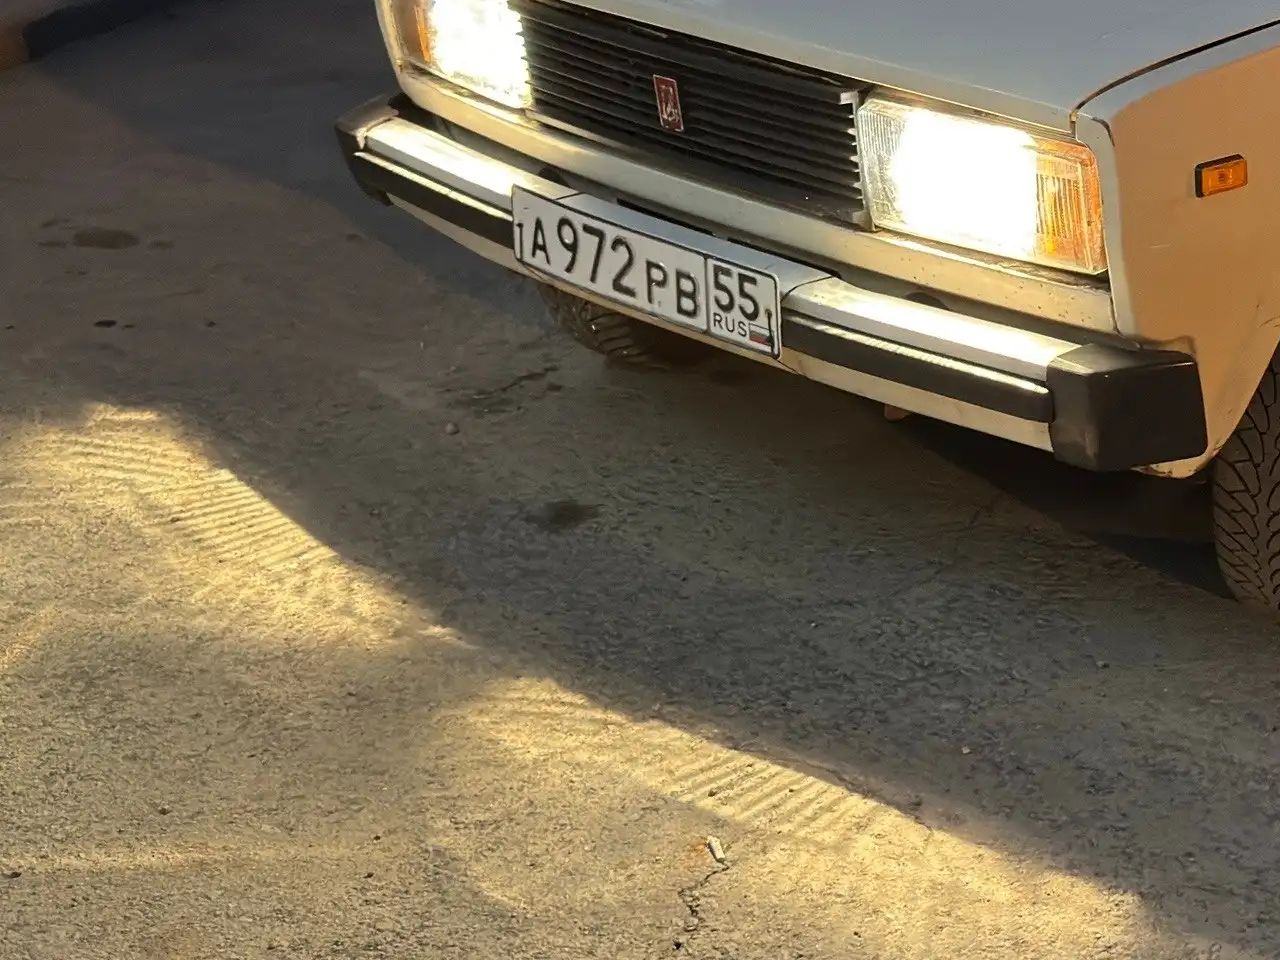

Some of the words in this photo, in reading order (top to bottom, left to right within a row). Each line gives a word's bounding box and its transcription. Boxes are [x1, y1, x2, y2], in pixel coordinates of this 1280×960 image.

[531, 217, 699, 318] А972РВ
[712, 263, 761, 323] 55
[712, 311, 748, 339] RUS
